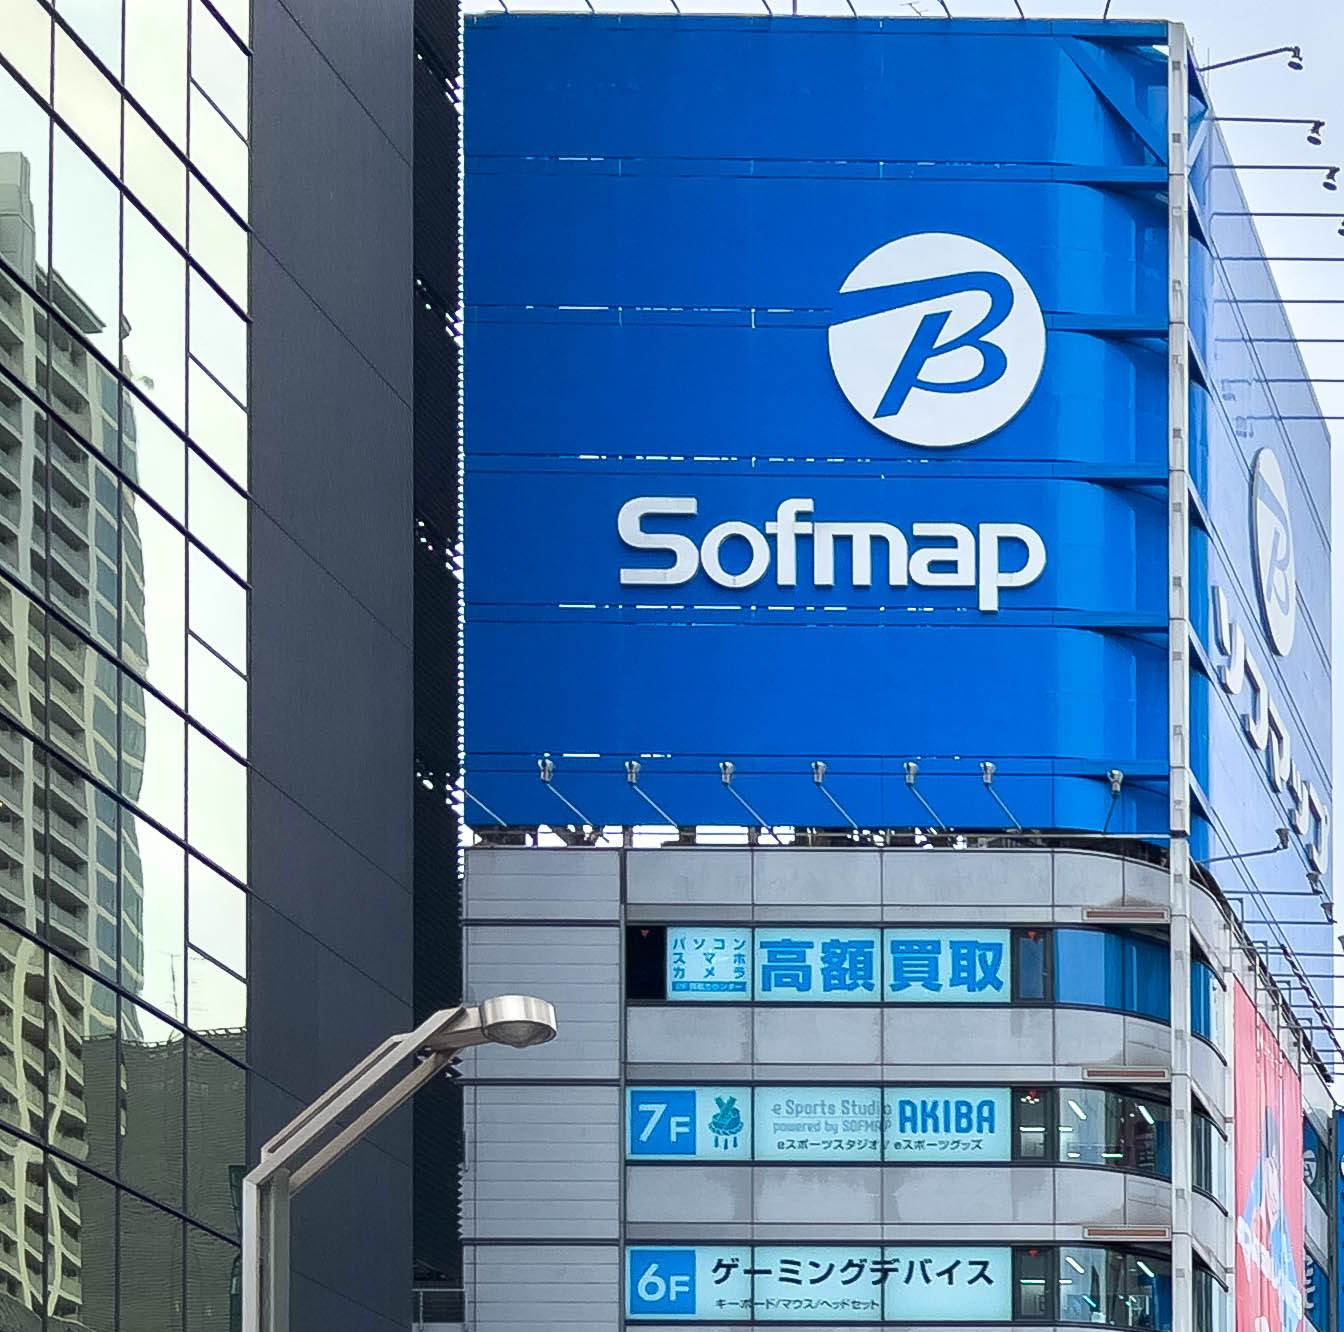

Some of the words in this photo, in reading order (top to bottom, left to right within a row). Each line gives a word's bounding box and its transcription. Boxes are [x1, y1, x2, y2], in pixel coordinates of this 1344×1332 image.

[616, 496, 1048, 612] Sofmap
[672, 937, 746, 951] パソコン
[759, 938, 1005, 993] 高額買取
[635, 1103, 692, 1143] 7F
[899, 1099, 997, 1135] AKIBA
[635, 1264, 692, 1305] 6F
[711, 1256, 995, 1288] ゲーミングデバイス
